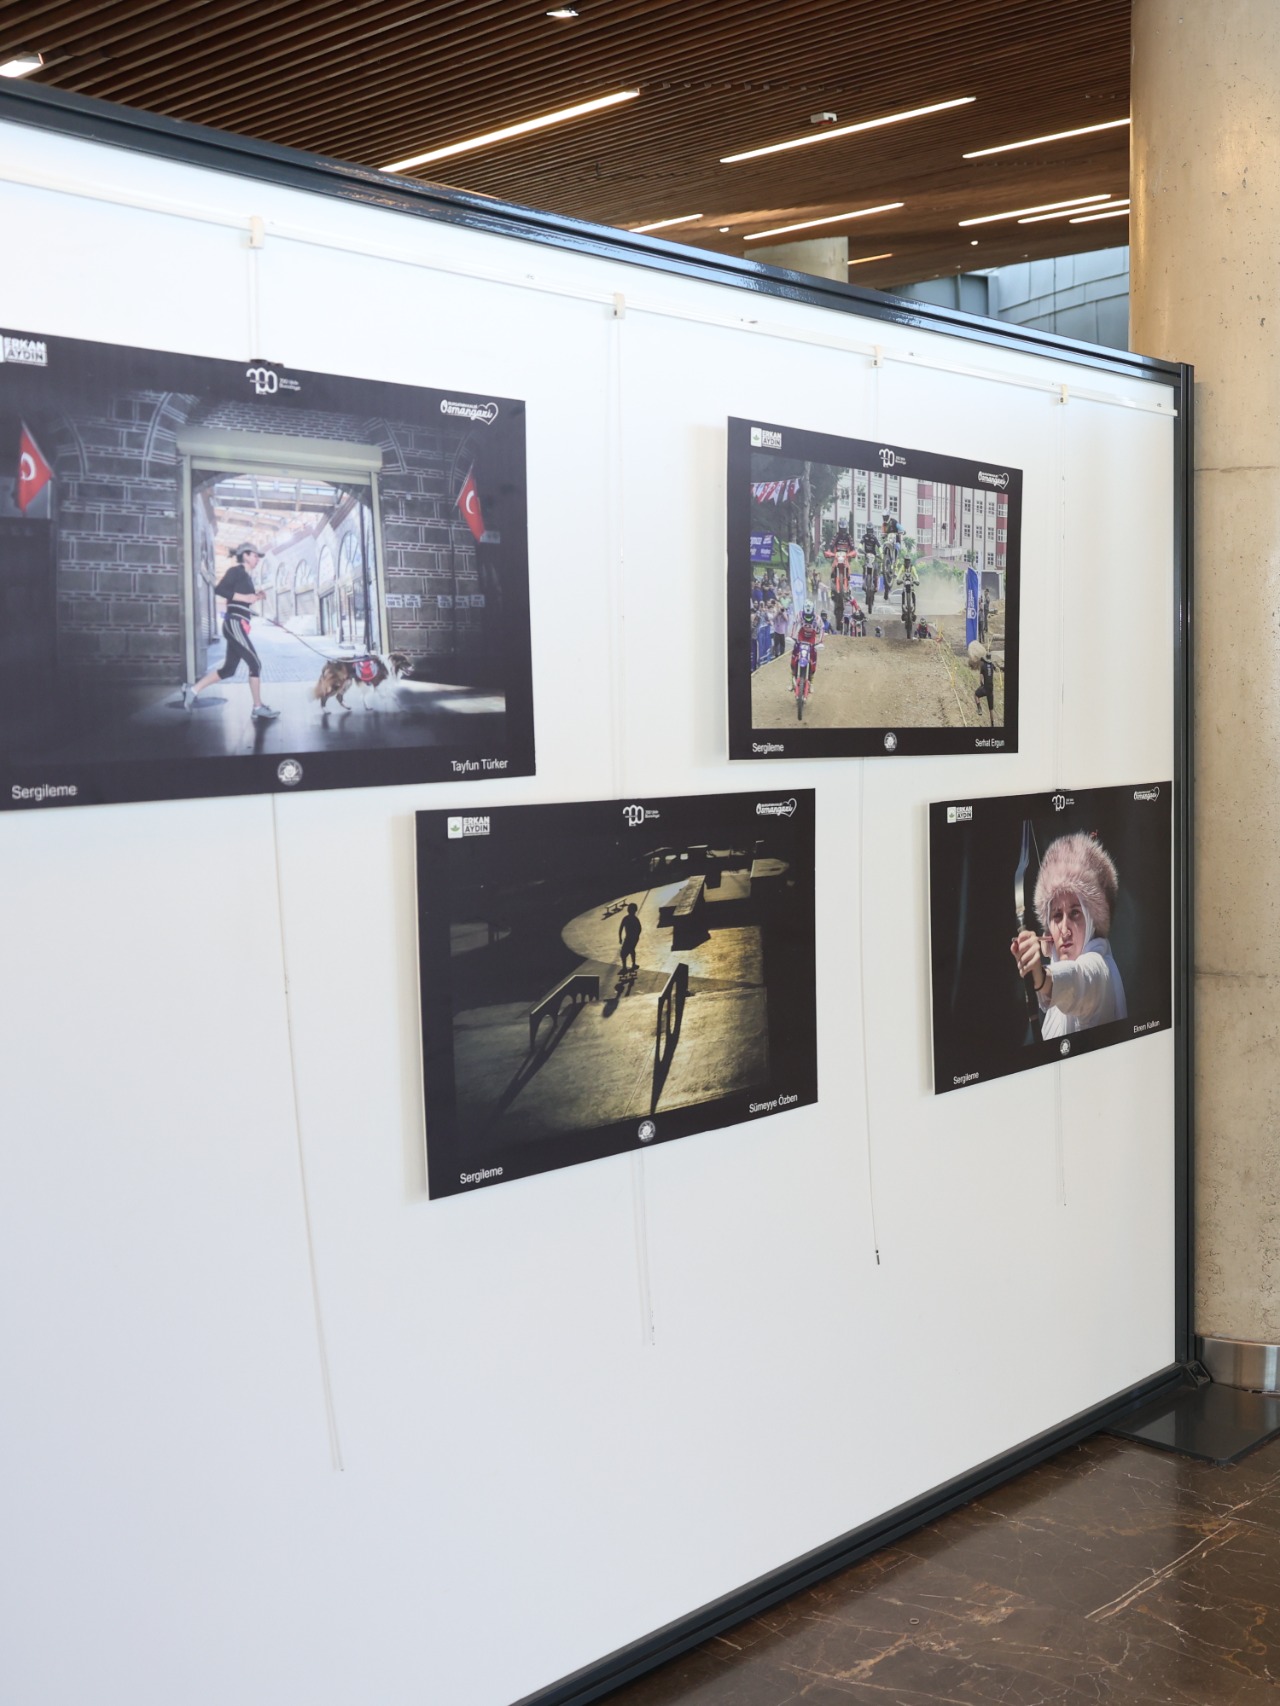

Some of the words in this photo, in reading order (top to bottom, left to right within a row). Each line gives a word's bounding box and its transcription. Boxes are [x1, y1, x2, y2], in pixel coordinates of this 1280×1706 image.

[3, 336, 46, 351] ERKAN
[7, 349, 45, 363] AYDIN
[440, 399, 493, 420] Osmangazi
[762, 429, 782, 439] ERKAN
[763, 437, 781, 446] AYDIN
[752, 742, 784, 754] Sergileme
[975, 738, 991, 747] Serhat
[451, 760, 479, 774] Tayfun
[481, 758, 508, 770] Türker
[11, 783, 77, 801] Sergileme
[463, 816, 490, 825] ERKAN
[465, 824, 489, 833] AYDIN
[953, 1071, 979, 1085] Sergileme
[749, 1098, 778, 1113] Sümeyye
[778, 1093, 798, 1105] Özben
[460, 1166, 503, 1184] Sergileme
